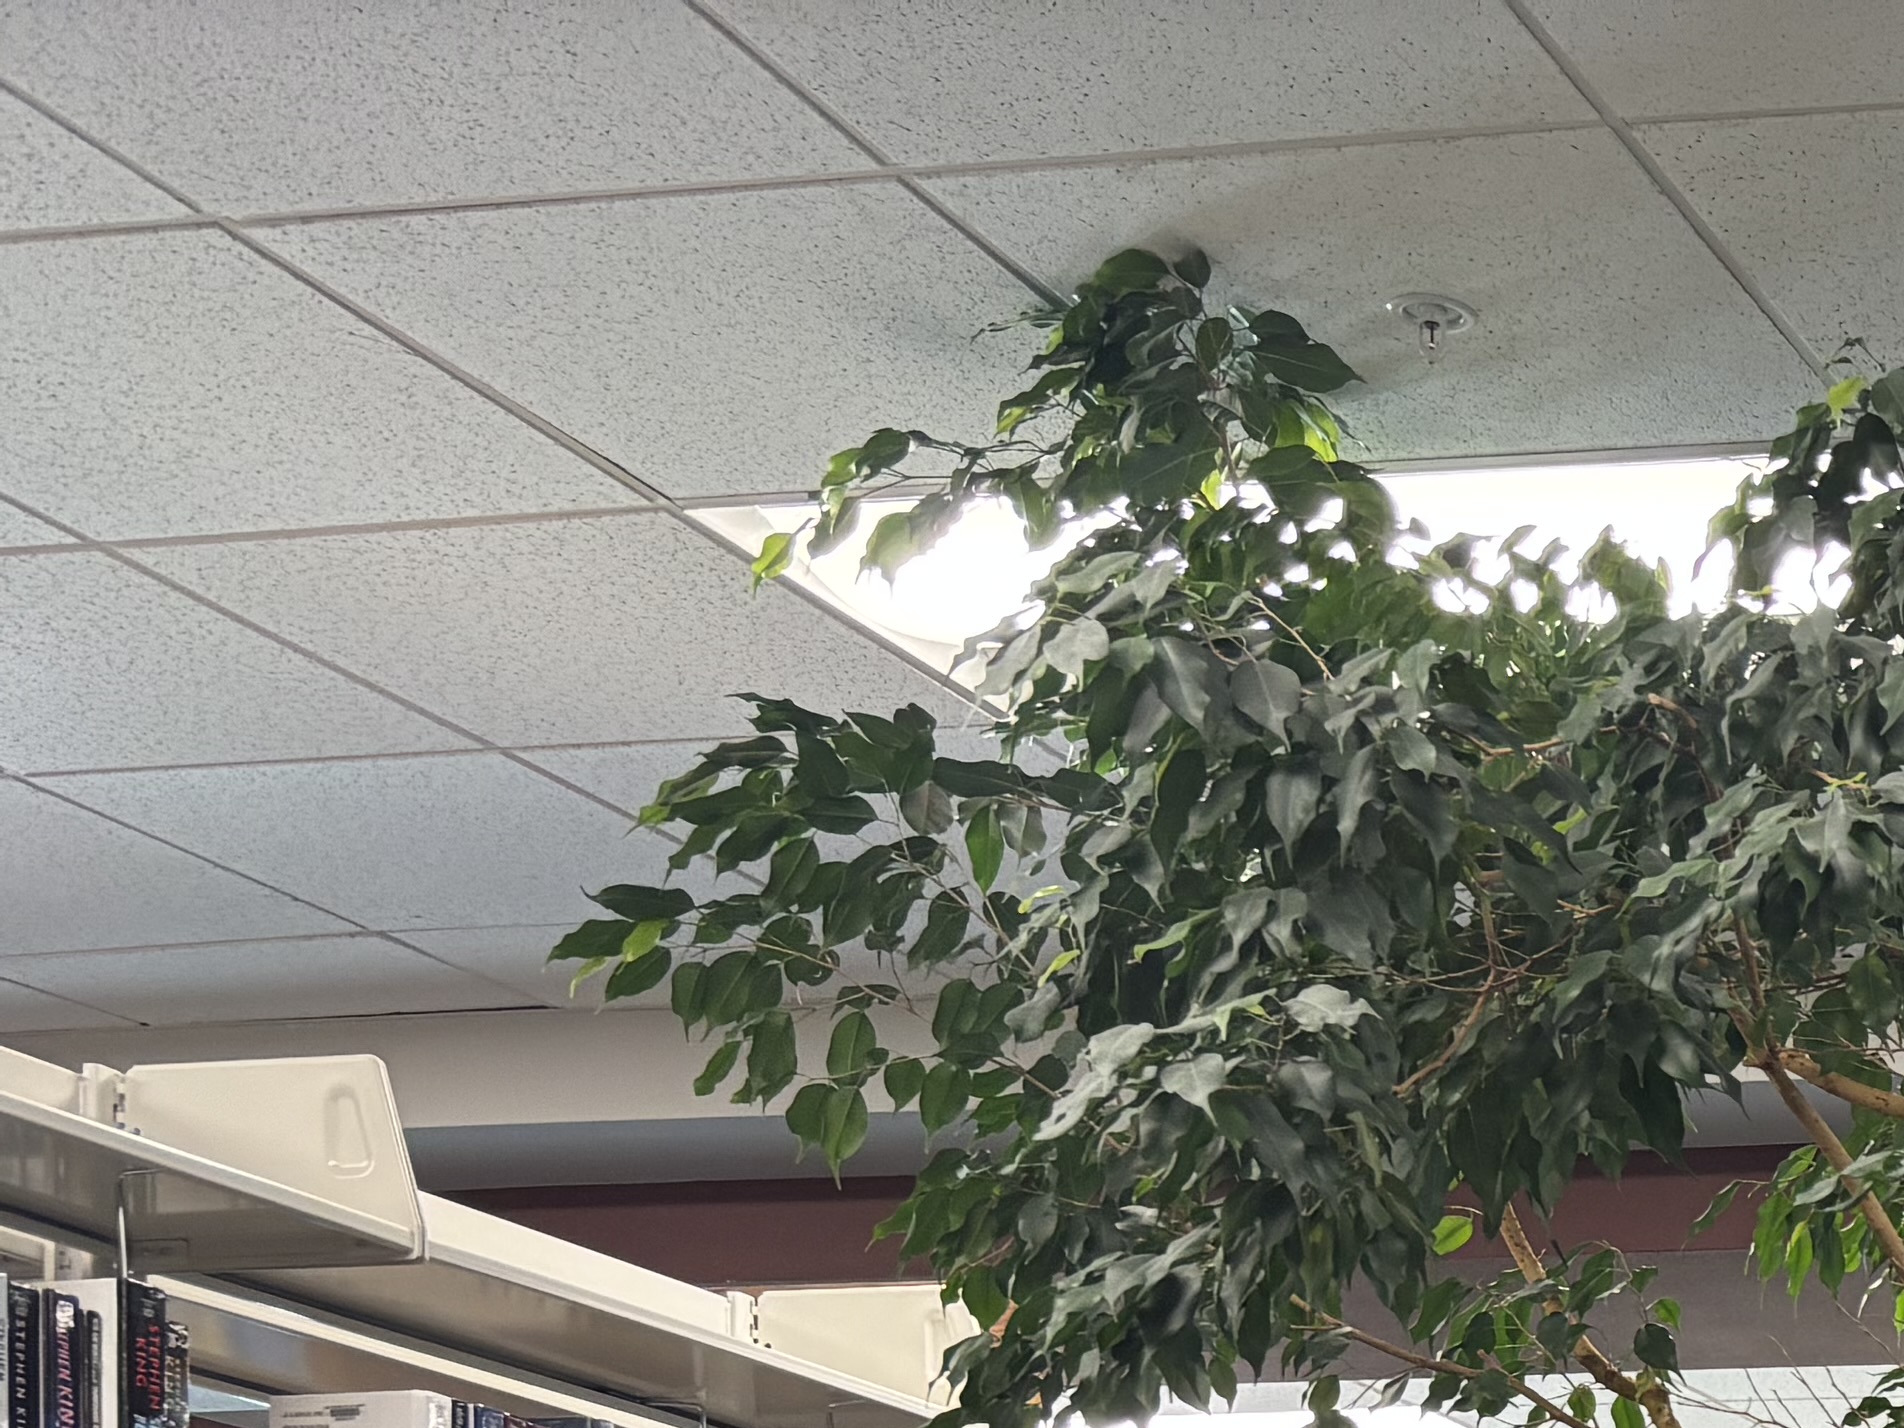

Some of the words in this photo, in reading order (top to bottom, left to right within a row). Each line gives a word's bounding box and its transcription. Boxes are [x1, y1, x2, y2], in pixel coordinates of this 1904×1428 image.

[15, 1319, 29, 1399] STEPHEN
[135, 1337, 148, 1388] KING
[148, 1325, 162, 1411] STEPHEN
